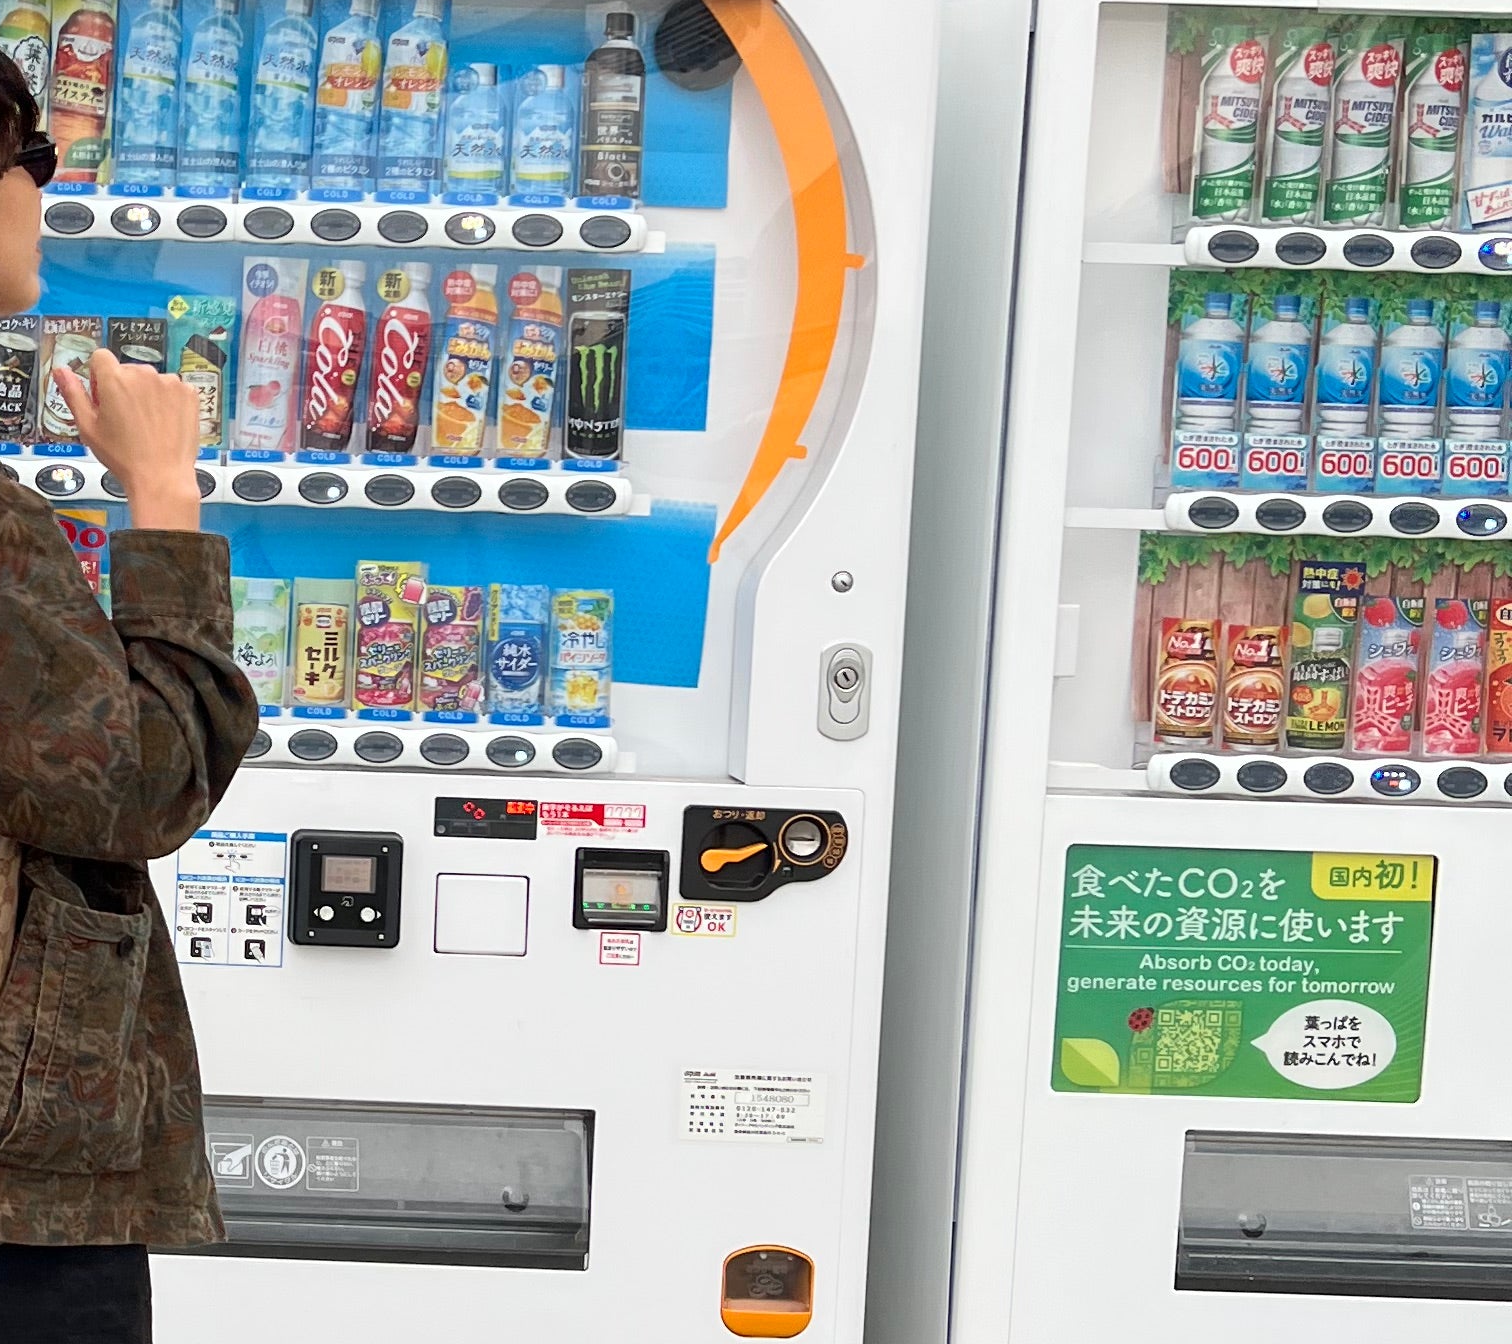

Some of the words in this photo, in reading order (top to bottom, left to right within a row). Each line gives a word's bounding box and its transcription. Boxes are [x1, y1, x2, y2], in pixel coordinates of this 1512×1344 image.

[1235, 60, 1265, 77] 爽快
[1308, 62, 1333, 79] 爽快
[1367, 63, 1398, 80] 爽快
[1439, 66, 1465, 85] 爽快
[452, 143, 504, 157] 天然水
[520, 145, 569, 159] 天然水
[597, 151, 627, 161] Black
[56, 182, 83, 192] COLD
[123, 184, 148, 193] COLD
[189, 186, 215, 195] COLD
[256, 188, 282, 197] COLD
[323, 191, 348, 199] COLD
[390, 192, 415, 200] COLD
[456, 194, 483, 203] COLD
[524, 196, 550, 204] COLD
[591, 197, 618, 206] COLD
[319, 271, 337, 287] 新
[384, 273, 402, 289] 新
[48, 445, 73, 453] COLD
[245, 450, 270, 459] COLD
[311, 452, 336, 461] COLD
[377, 454, 402, 463] COLD
[444, 456, 469, 465] COLD
[510, 458, 536, 467] COLD
[1178, 447, 1230, 471] 600
[1248, 451, 1299, 474] 600
[577, 460, 602, 468] COLD
[1320, 453, 1367, 475] 600
[1383, 454, 1433, 476] 600
[1449, 456, 1500, 479] 600
[561, 631, 606, 649] 冷やし
[1169, 632, 1203, 649] No.1
[502, 643, 531, 657] 純水
[1235, 639, 1269, 656] No.1
[324, 631, 339, 679] ミルク
[305, 646, 322, 686] セーキ
[495, 657, 538, 671] サイダー
[306, 707, 332, 716] COLD
[372, 709, 397, 718] COLD
[438, 711, 464, 720] COLD
[504, 713, 530, 723] COLD
[570, 716, 596, 725] COLD
[1330, 859, 1419, 891] 国内初!
[707, 922, 726, 932] OK
[1069, 905, 1404, 944] 未来の資源に使います
[1140, 954, 1212, 971] Absorb
[1259, 956, 1320, 976] today,
[1067, 976, 1157, 993] generate
[1163, 978, 1262, 993] resources
[1267, 977, 1297, 993] for
[1301, 979, 1395, 995] tomorrow
[1304, 1015, 1362, 1032] 葉っぱを
[1303, 1034, 1361, 1050] スマホで
[1284, 1051, 1377, 1068] 読みこんでね!
